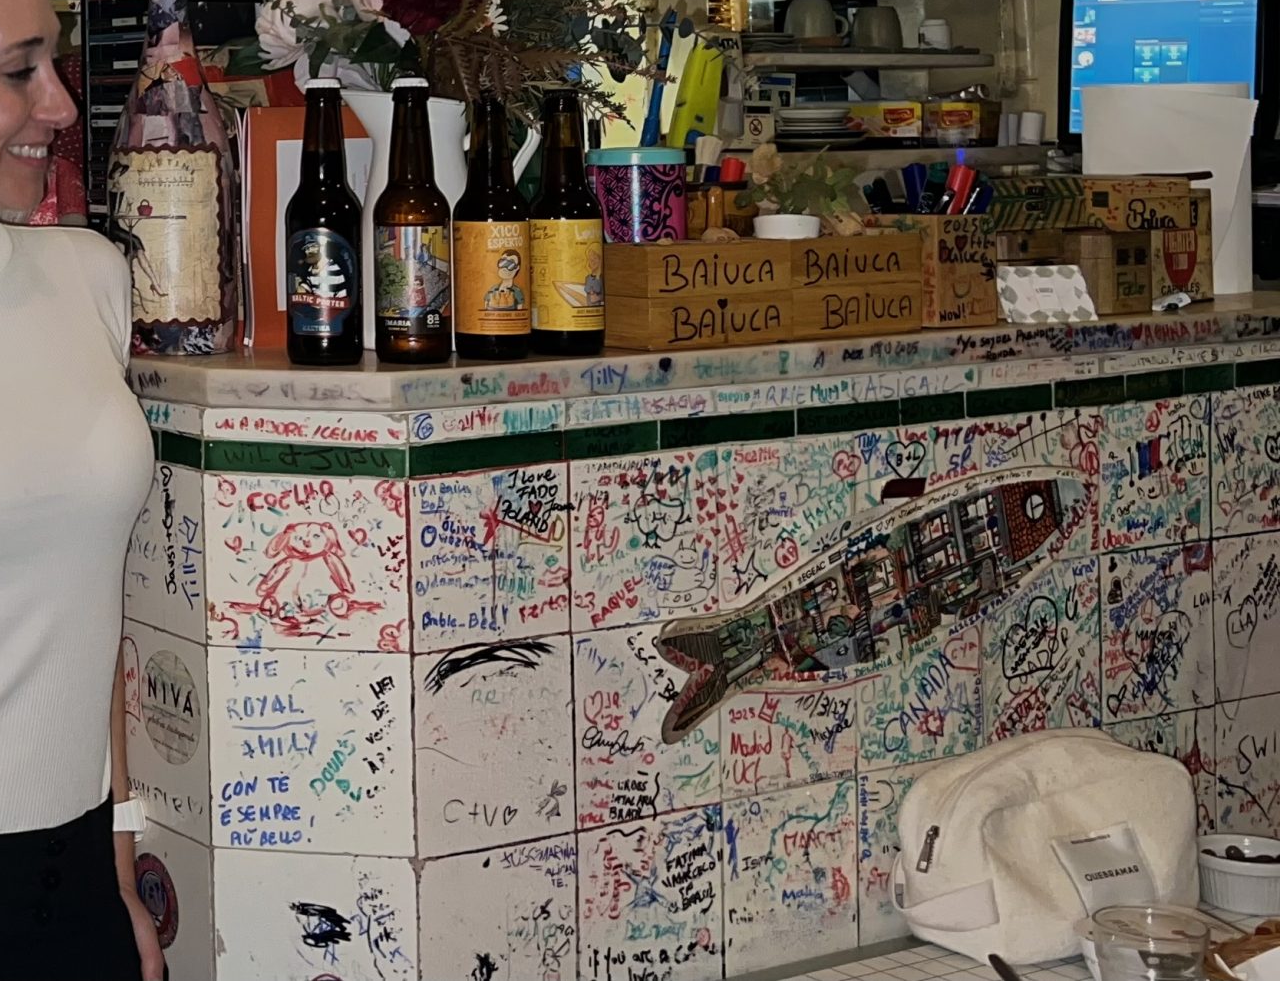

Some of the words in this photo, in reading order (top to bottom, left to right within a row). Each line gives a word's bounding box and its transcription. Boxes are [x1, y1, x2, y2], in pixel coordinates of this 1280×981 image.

[489, 224, 521, 238] XICO
[487, 237, 523, 250] ESPERTO
[316, 298, 345, 308] PORTER
[580, 363, 629, 394] Tilly
[733, 448, 780, 465] Seattle
[516, 484, 559, 501] FADO
[147, 673, 194, 718] NIVA
[883, 651, 958, 753] CANADA
[226, 692, 305, 721] ROYAL
[730, 725, 773, 758] Madrid
[221, 775, 258, 802] CON
[267, 774, 291, 794] TE
[237, 805, 302, 825] SEMPRE
[1084, 864, 1140, 882] QUEBRAMAR
